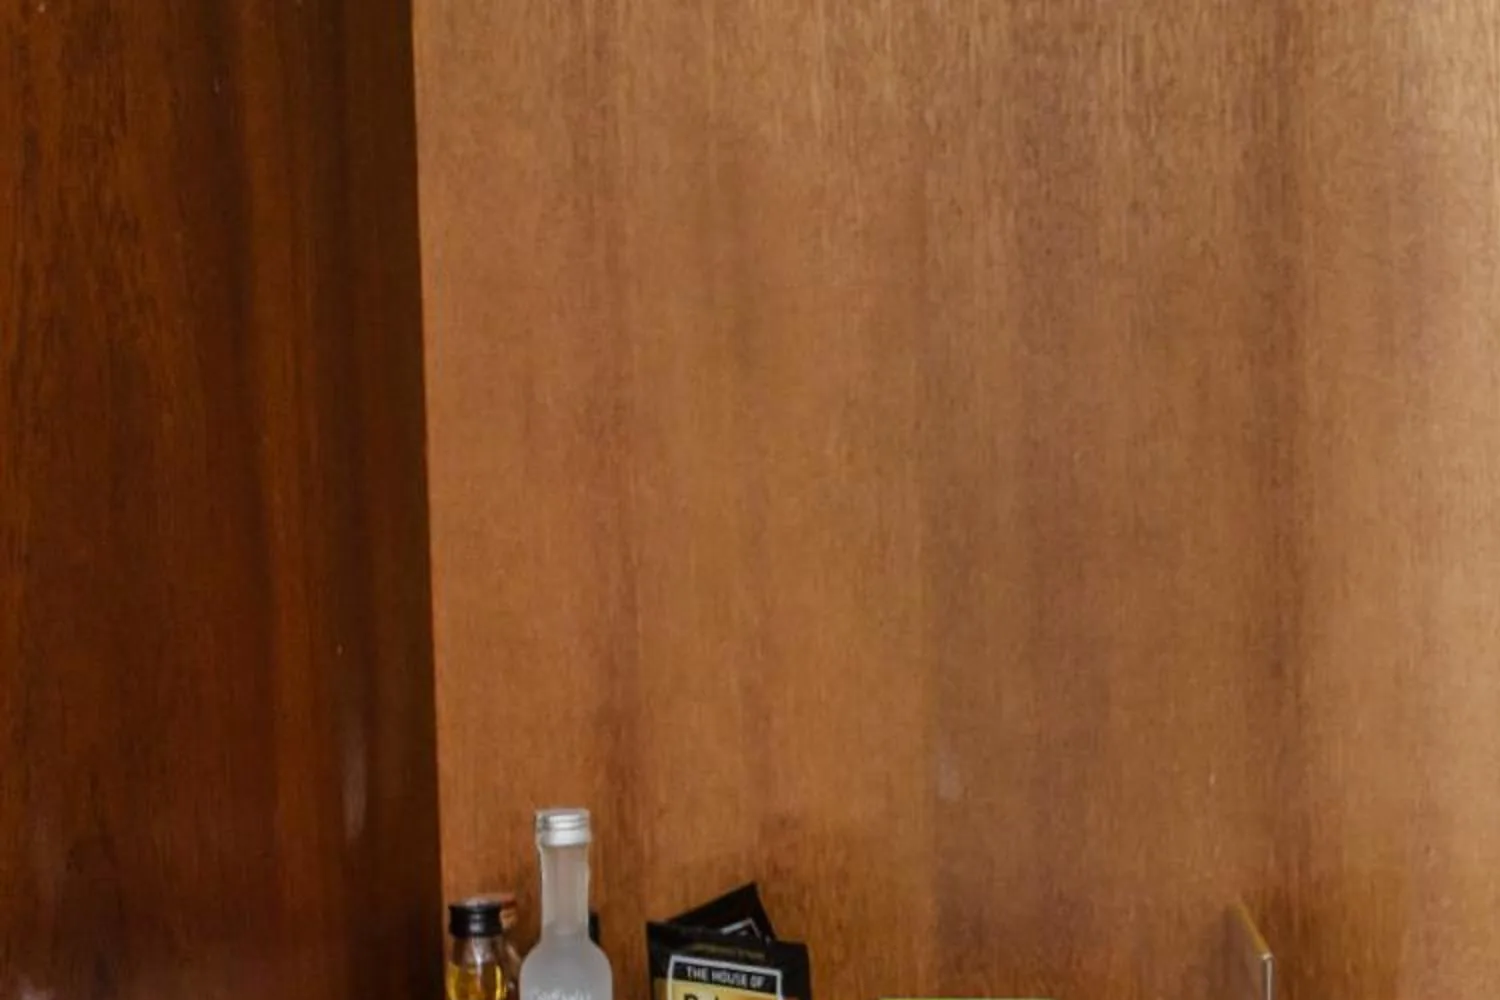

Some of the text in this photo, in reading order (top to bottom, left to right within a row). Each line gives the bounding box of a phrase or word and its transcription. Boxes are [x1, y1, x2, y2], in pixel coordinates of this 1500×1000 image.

[686, 964, 765, 988] THE HOUSE OF
